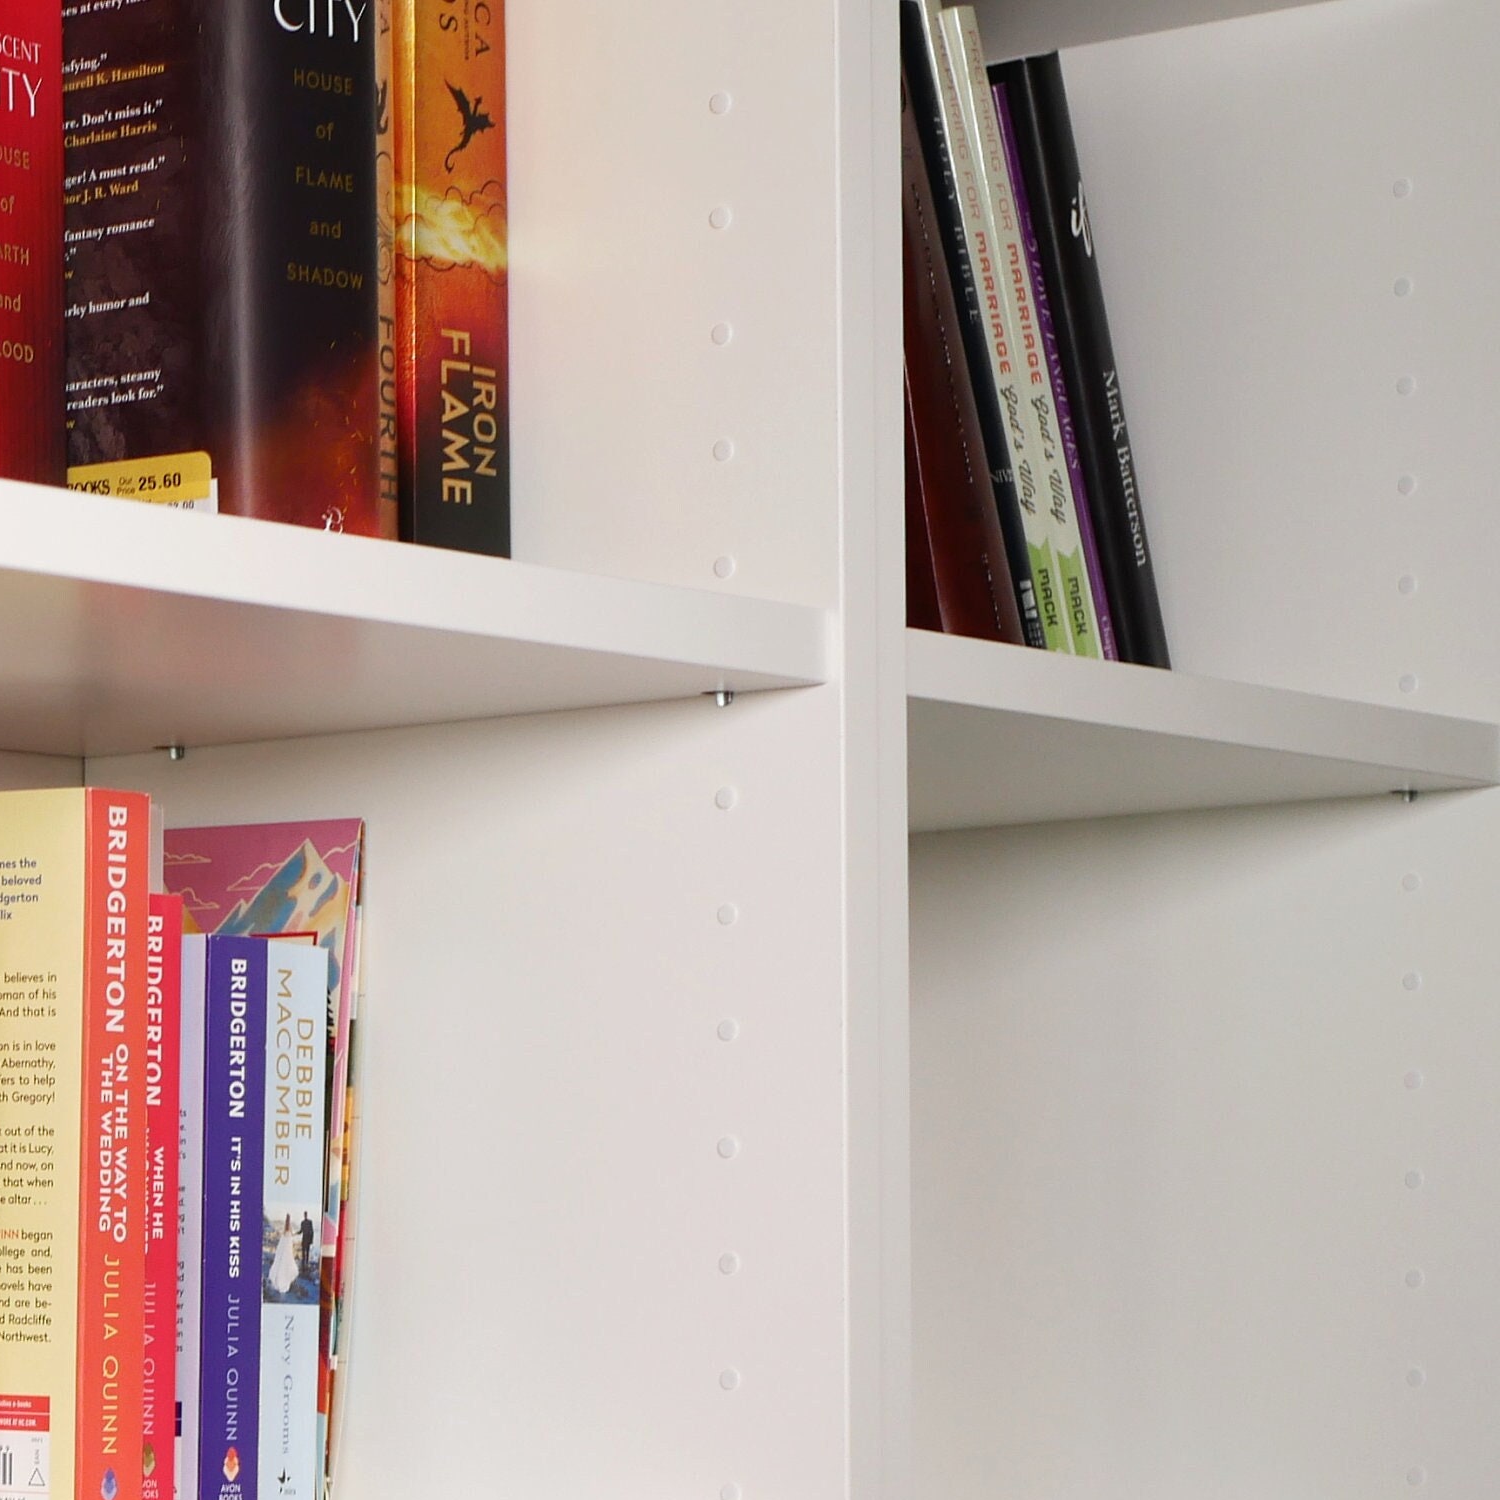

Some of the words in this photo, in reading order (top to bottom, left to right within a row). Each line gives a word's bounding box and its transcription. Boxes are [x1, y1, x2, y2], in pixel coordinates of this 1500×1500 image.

[111, 62, 165, 83] Hamilton
[294, 68, 352, 95] HOUSE
[63, 128, 118, 148] Charlaine
[120, 119, 158, 139] Harris
[316, 122, 333, 142] of
[0, 195, 15, 214] of
[295, 166, 354, 193] FLAME
[64, 226, 105, 244] fantasy
[106, 217, 155, 237] romance
[309, 218, 342, 239] and
[286, 262, 363, 291] SHADOW
[378, 315, 397, 502] FOURTH
[440, 328, 474, 506] FLAME
[472, 365, 497, 478] IRON
[975, 231, 1011, 375] MARRIAGE
[1019, 459, 1037, 515] Way
[1038, 569, 1058, 626] MACK
[1006, 243, 1043, 385] MARRIAGE
[1049, 468, 1067, 525] Way
[1068, 577, 1087, 636] MACK
[138, 472, 182, 492] 25.60
[1103, 370, 1126, 441] Mark
[1117, 446, 1146, 568] Batterson
[19, 856, 37, 870] the
[105, 805, 128, 1033] BRIDGERTON
[146, 915, 164, 1106] BRIDGERTON
[115, 1043, 129, 1082] ON
[228, 958, 247, 1118] BRIDGERTON
[100, 1052, 114, 1103] THE
[274, 968, 293, 1186] MACOMBER
[295, 1018, 314, 1140] DEBBIE
[114, 1088, 128, 1140] THE
[98, 1110, 113, 1232] WEDDING
[113, 1146, 128, 1203] WAY
[152, 1146, 165, 1207] WHEN
[230, 1136, 242, 1173] IT'S
[230, 1175, 241, 1196] IN
[112, 1206, 127, 1244] TO
[152, 1211, 164, 1239] HE
[229, 1200, 241, 1232] HIS
[228, 1236, 240, 1278] KISS
[103, 1253, 120, 1340] JULIA
[227, 1293, 240, 1358] JULIA
[283, 1315, 295, 1366] Navy
[102, 1355, 119, 1454] QUINN
[225, 1367, 239, 1441] QUINN
[282, 1373, 293, 1455] Grooms
[220, 1483, 241, 1494] AVON
